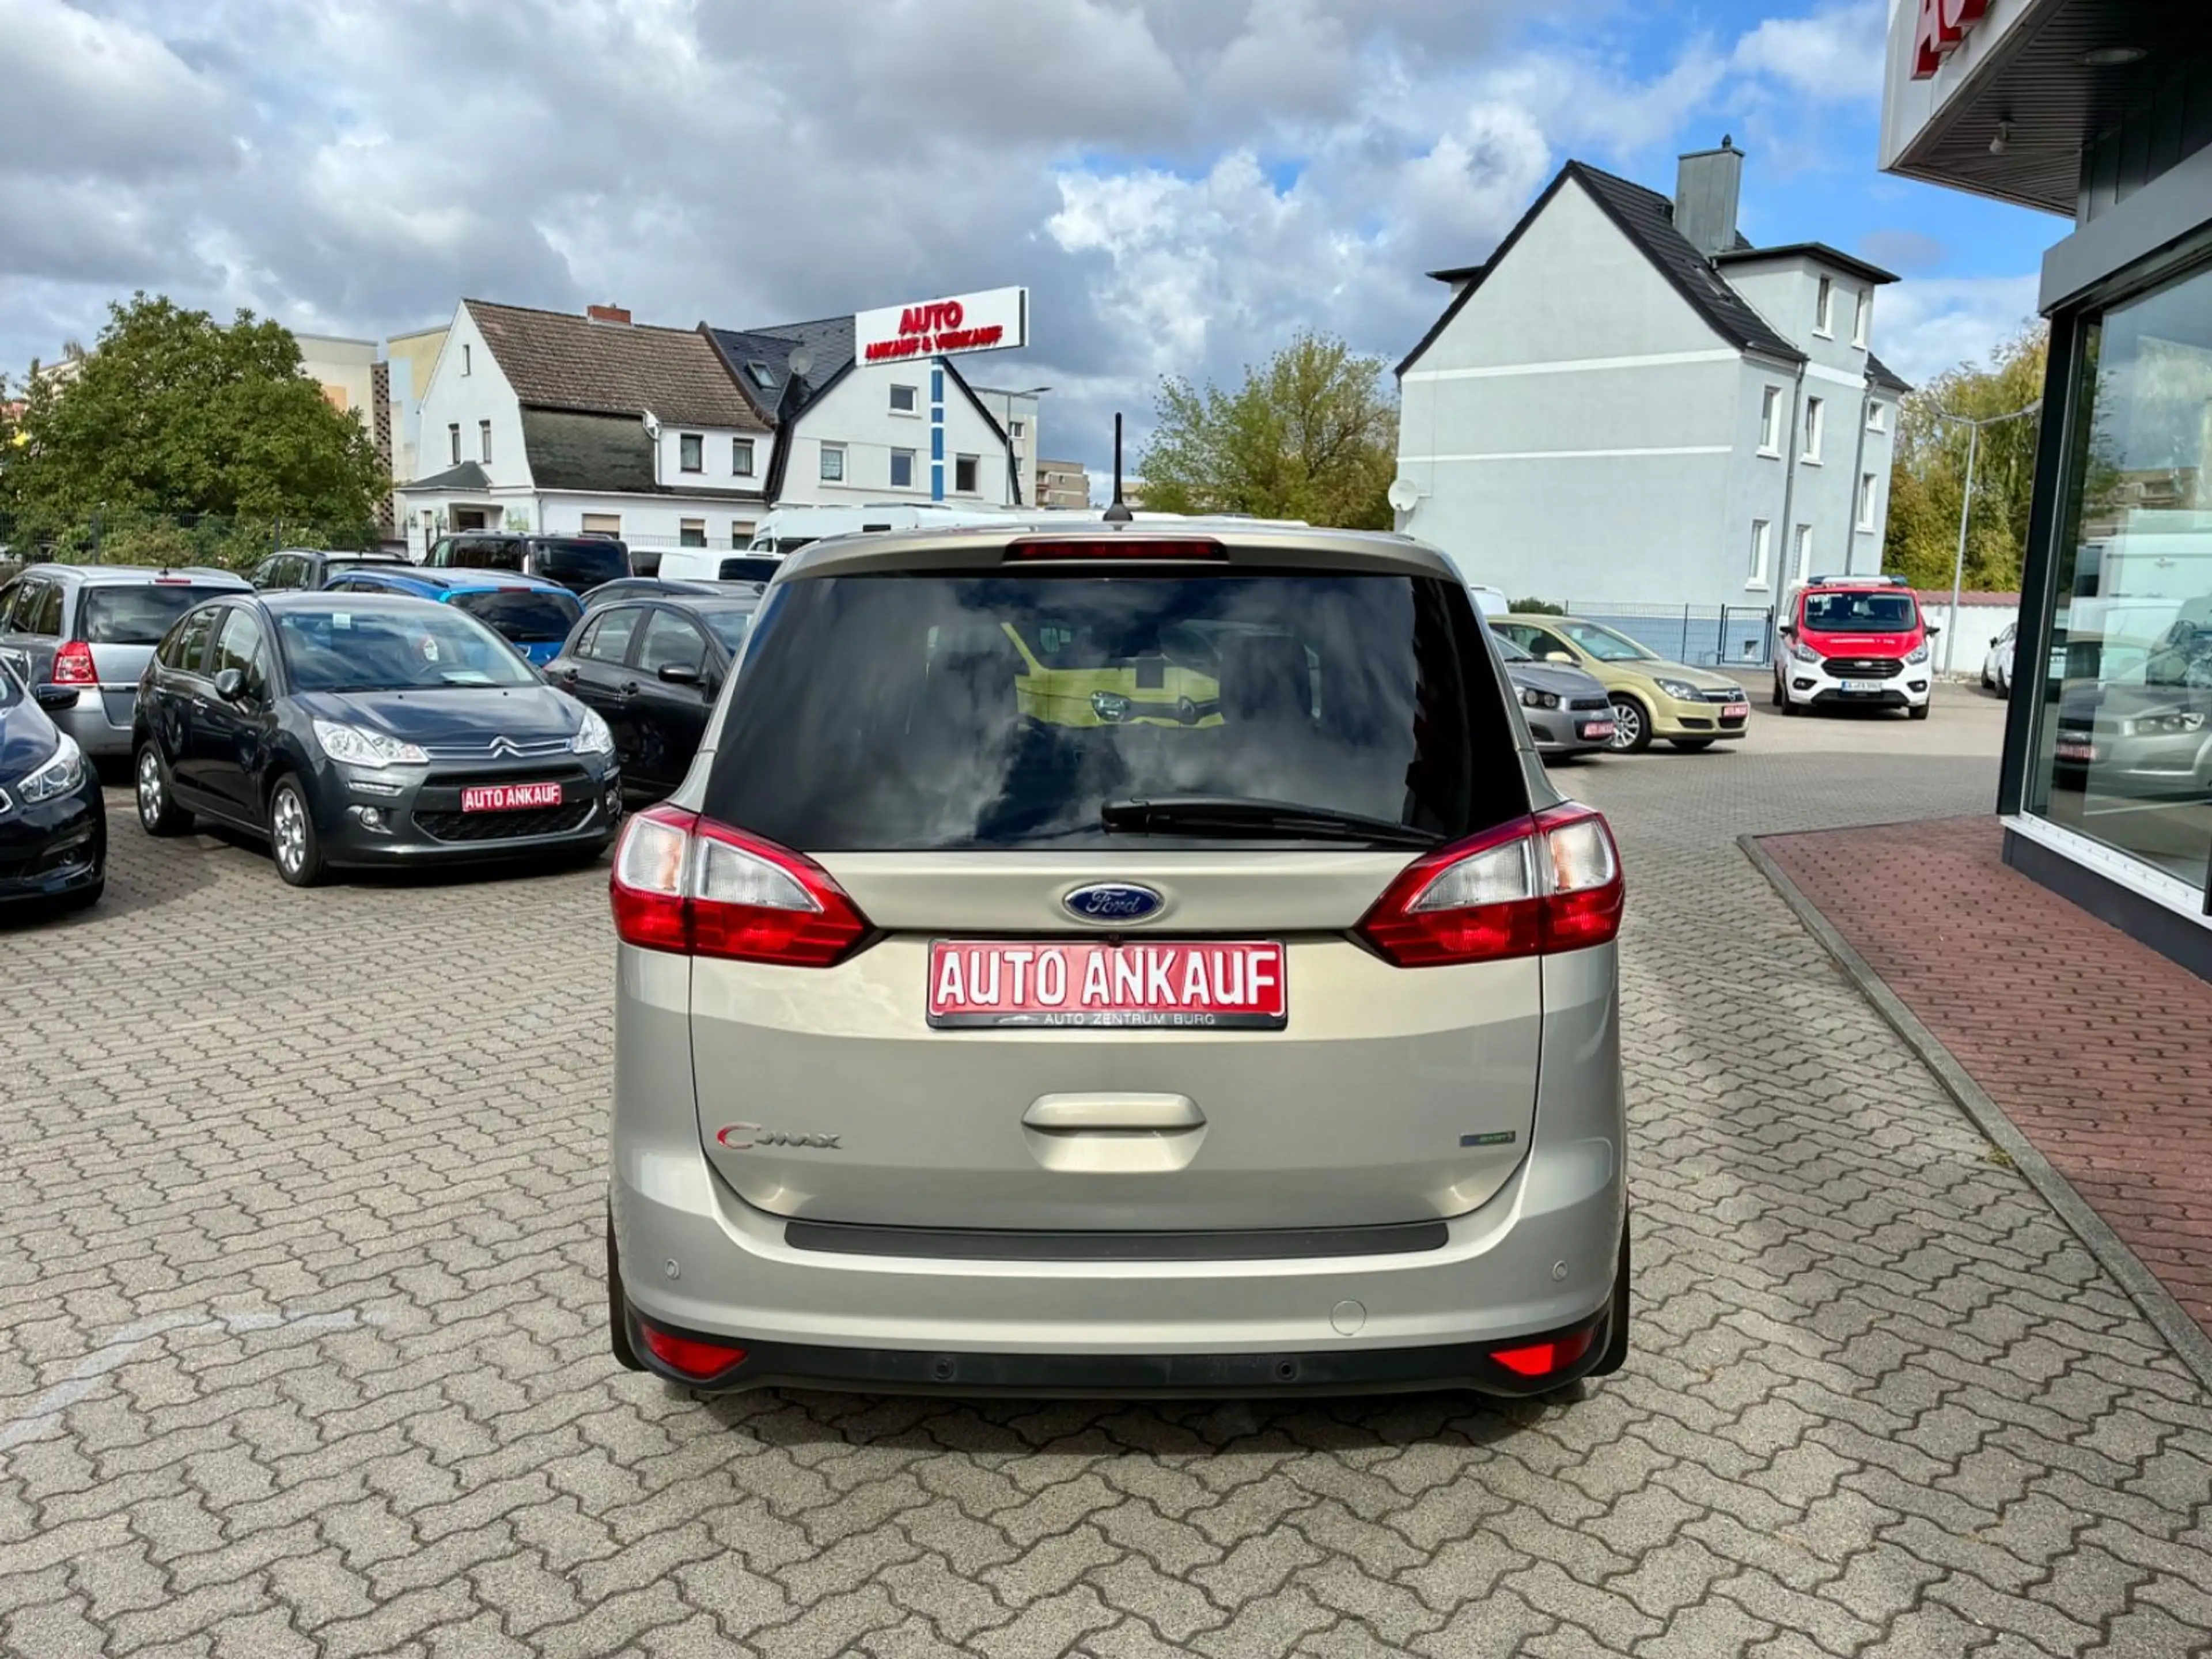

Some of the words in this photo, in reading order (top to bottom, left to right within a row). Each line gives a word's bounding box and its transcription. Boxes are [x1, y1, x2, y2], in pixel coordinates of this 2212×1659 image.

[898, 300, 963, 335] AUTO
[465, 789, 503, 809] AUTO
[506, 785, 560, 805] ANKAUF
[1086, 890, 1141, 913] Ford
[937, 951, 1067, 1005] AUTO
[1081, 950, 1277, 1005] ANKAUF
[1044, 1013, 1084, 1025] AUTO
[1093, 1013, 1165, 1025] ZENTRUM
[1173, 1013, 1215, 1025] BURG
